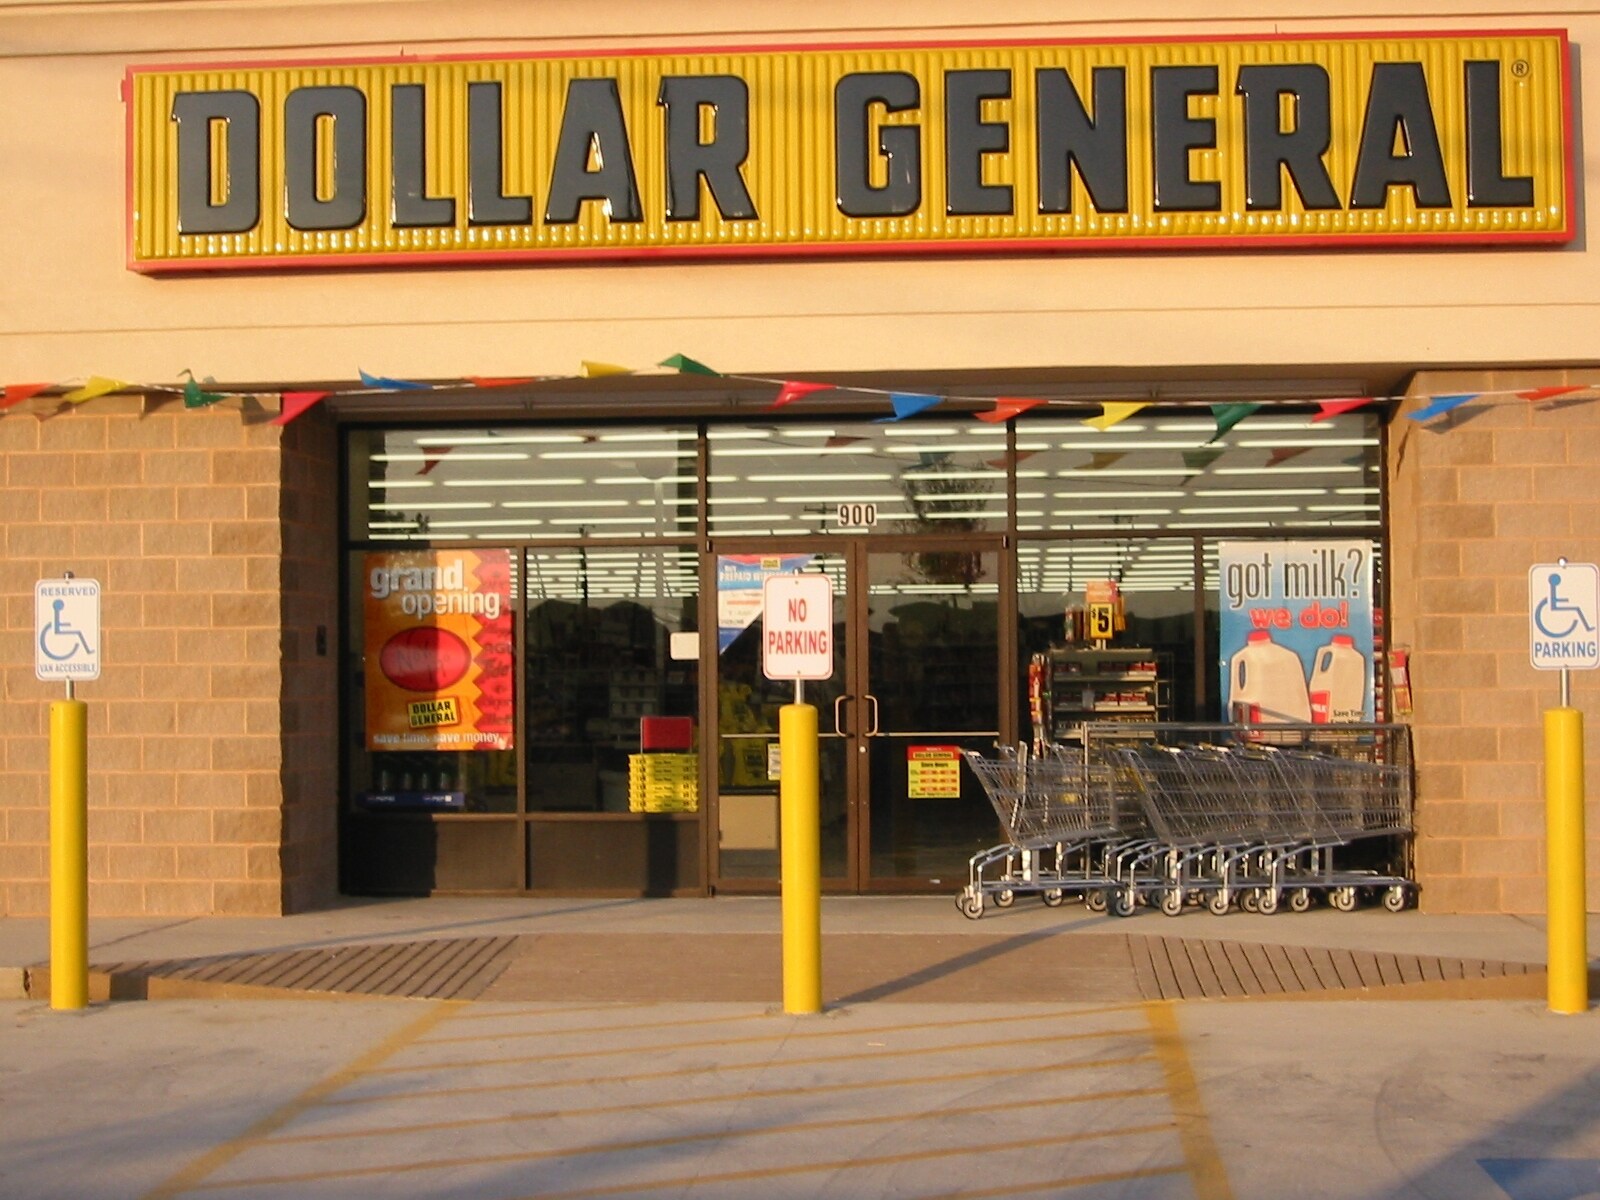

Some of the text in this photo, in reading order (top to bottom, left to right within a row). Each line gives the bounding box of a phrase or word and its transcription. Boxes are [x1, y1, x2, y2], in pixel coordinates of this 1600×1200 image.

[171, 75, 760, 236] DOLLAR
[835, 60, 1534, 216] GENERAL
[840, 504, 874, 525] 900
[370, 559, 464, 598] grand
[1227, 548, 1364, 609] got milk?
[40, 587, 97, 596] RESERVED
[401, 586, 500, 620] opening
[787, 598, 807, 622] NO
[1249, 600, 1349, 629] we do!
[768, 630, 828, 655] PARKING
[1534, 641, 1597, 658] PARKING
[40, 664, 96, 673] VAN ACCESSIBLE
[411, 711, 456, 726] GENERAL
[412, 701, 452, 714] DOLLAR
